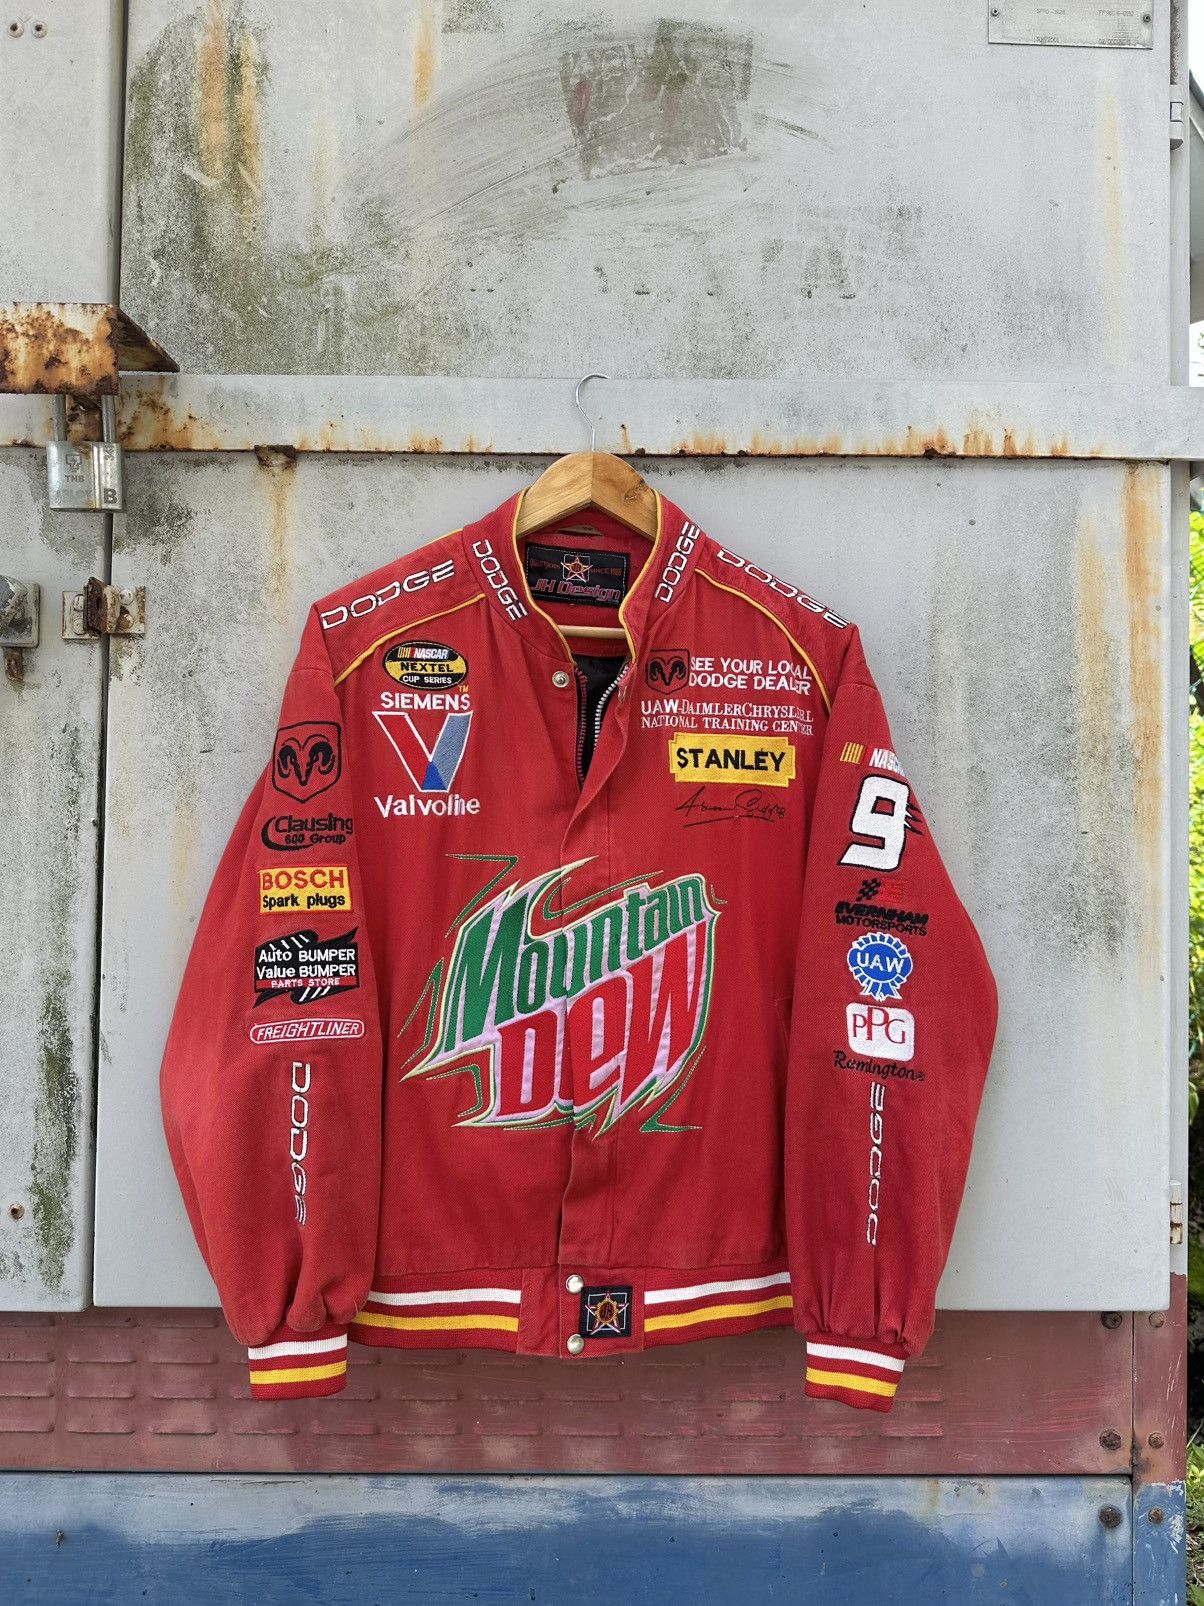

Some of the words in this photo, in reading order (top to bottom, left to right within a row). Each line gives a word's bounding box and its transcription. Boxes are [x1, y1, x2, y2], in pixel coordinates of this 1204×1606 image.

[103, 488, 118, 504] B
[654, 521, 700, 603] DODGE
[472, 539, 528, 621] DODGE
[557, 580, 621, 602] Design
[716, 547, 851, 629] DODGE
[320, 559, 456, 630] DODGE
[413, 647, 449, 660] NASCAR
[400, 662, 454, 673] NEXTEL
[690, 657, 714, 671] SEE
[720, 658, 763, 674] YOUR
[402, 675, 420, 683] CUP
[424, 676, 452, 684] SERIES
[689, 673, 748, 689] DODGE
[380, 691, 470, 710] SIEMENS
[641, 715, 698, 729] NATIONAL
[703, 718, 768, 732] TRAINING
[676, 747, 786, 772] STANLEY
[374, 793, 480, 819] Valvoline
[275, 812, 353, 835] Clausing
[837, 773, 911, 873] 9
[310, 833, 346, 845] Group
[262, 869, 345, 891] BOSCH
[263, 894, 300, 909] Spark
[306, 893, 346, 908] plugs
[835, 914, 928, 937] MOTORSPORTS
[259, 949, 293, 963] Auto
[298, 949, 356, 962] BUMPER
[444, 868, 706, 1053] Mountain
[856, 952, 905, 974] UAW
[256, 964, 296, 980] Value
[299, 964, 356, 977] BUMPER
[271, 979, 303, 988] PARTS
[308, 977, 341, 987] STORE
[256, 1021, 360, 1041] FREIGHTLINER
[852, 1006, 906, 1044] PPG
[290, 1061, 311, 1226] DODGE
[866, 1081, 886, 1246] DODGE
